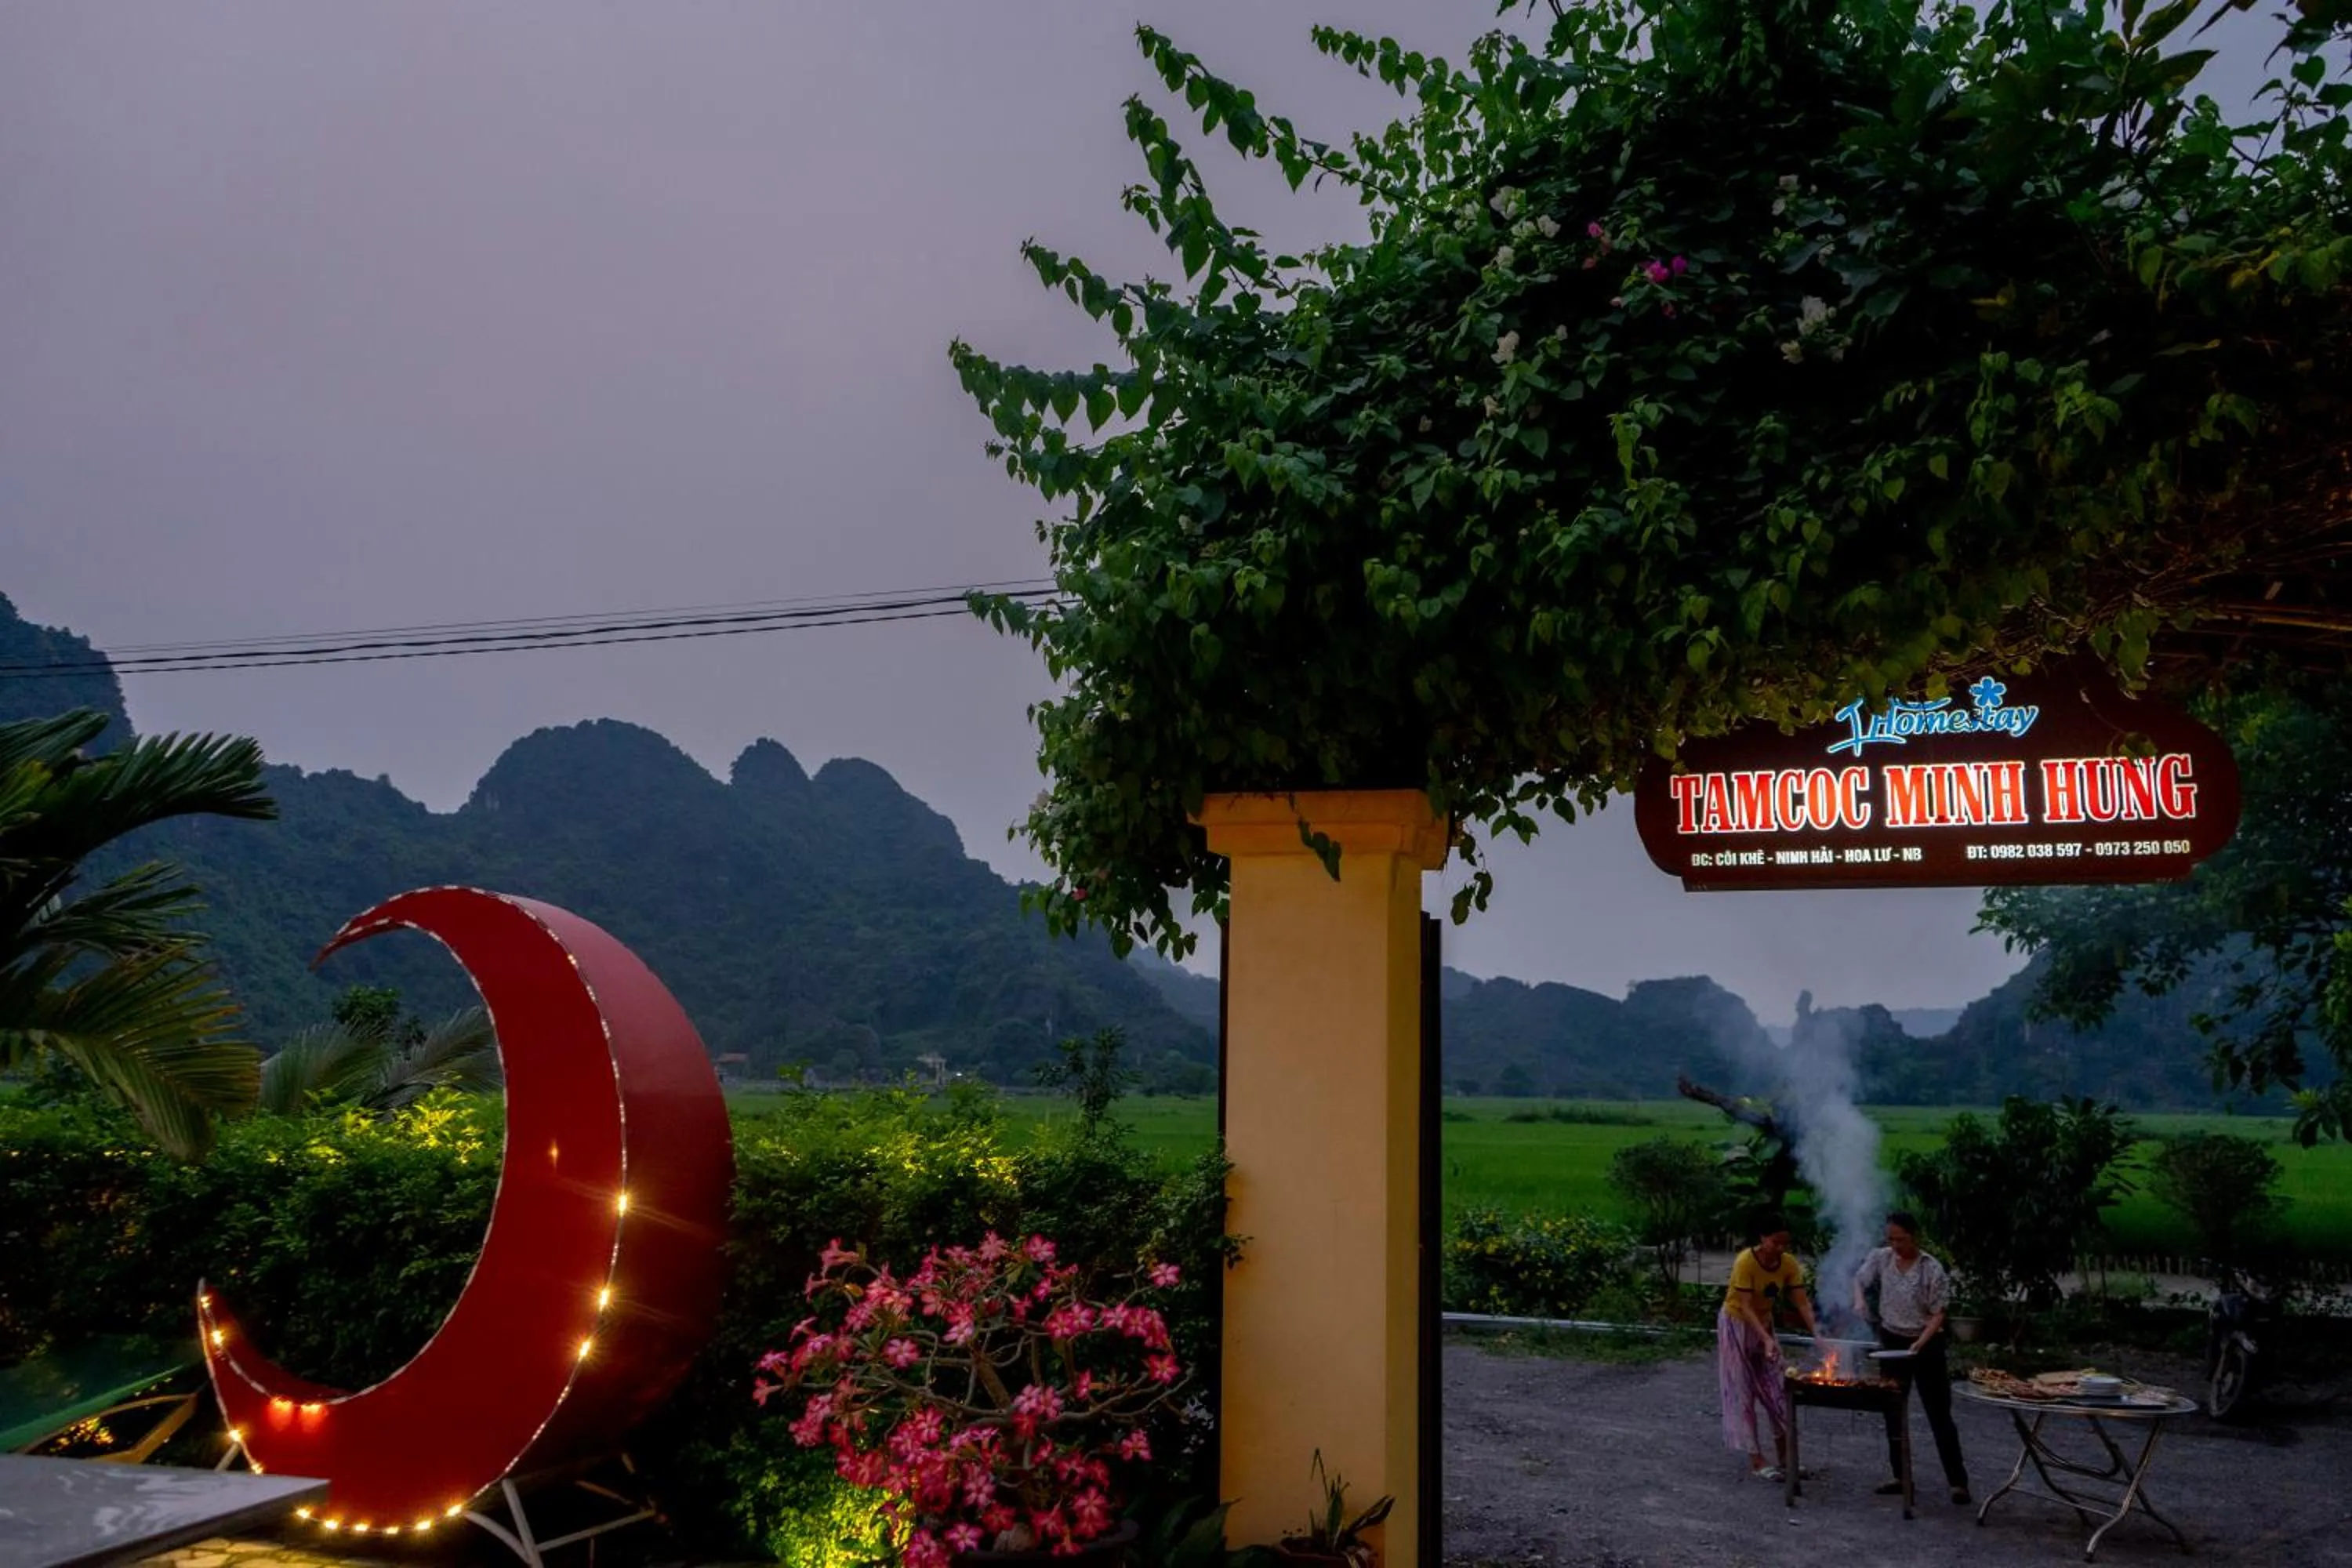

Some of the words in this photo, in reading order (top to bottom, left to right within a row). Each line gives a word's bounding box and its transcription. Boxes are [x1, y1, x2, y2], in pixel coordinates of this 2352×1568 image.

[1671, 766, 1871, 833] TAMCOC
[1883, 760, 2029, 828] MINH
[1775, 851, 1809, 864] NINH
[1810, 846, 1834, 863] HẢI
[1845, 849, 1872, 862] HOA
[1874, 847, 1893, 862] LƯ
[1902, 848, 1922, 861] NB
[1991, 844, 2025, 858] 0982
[2027, 844, 2053, 858] 038
[2056, 843, 2082, 857] 597
[2095, 841, 2130, 855] 0973
[2133, 840, 2160, 855] 250
[2164, 840, 2190, 854] 050
